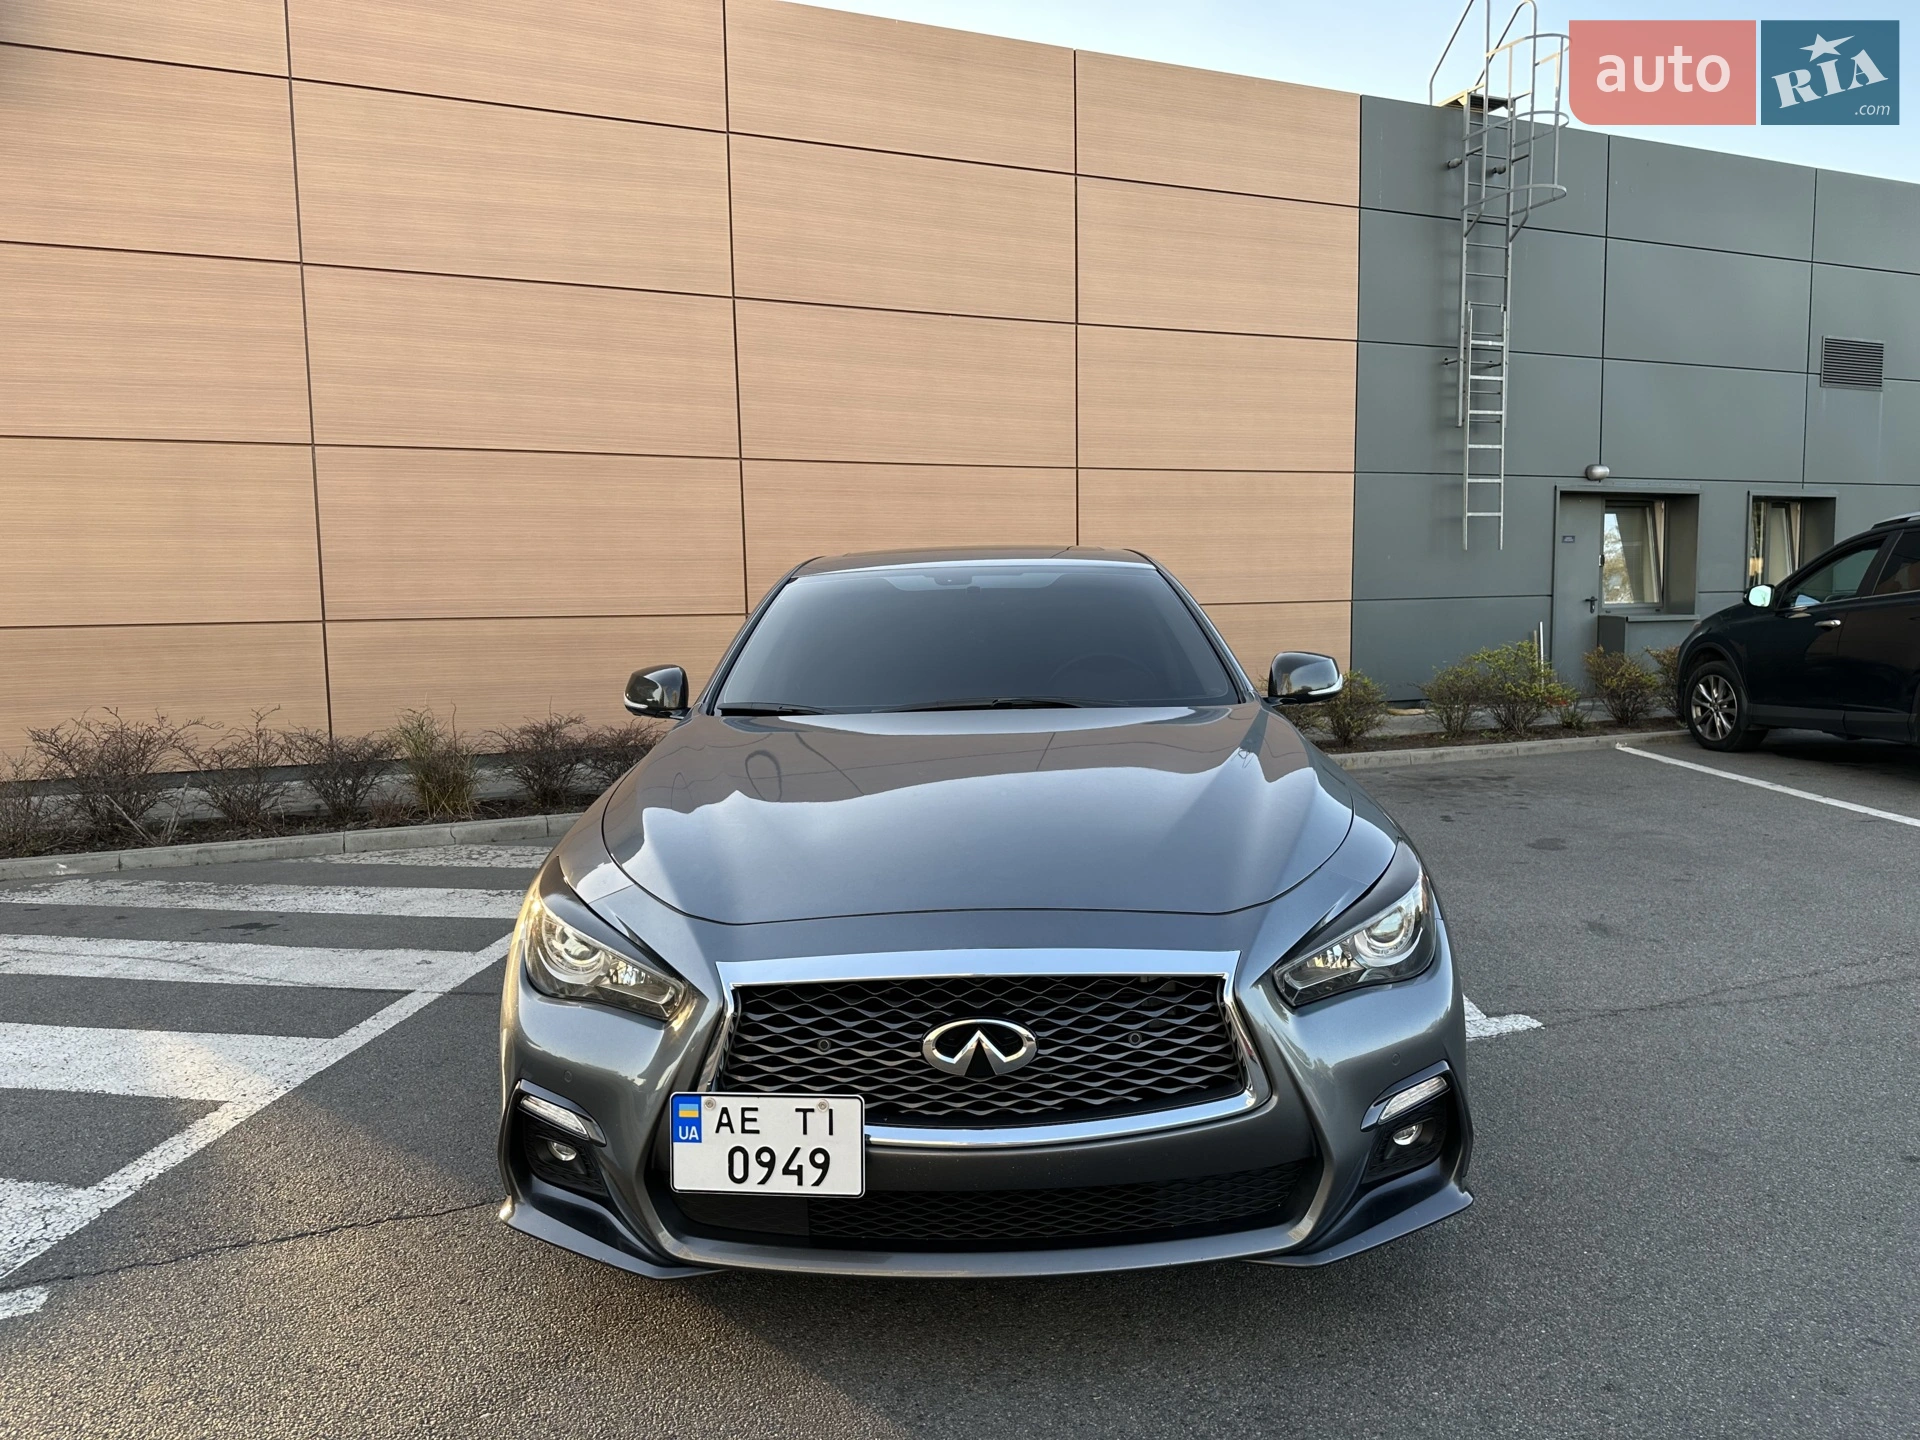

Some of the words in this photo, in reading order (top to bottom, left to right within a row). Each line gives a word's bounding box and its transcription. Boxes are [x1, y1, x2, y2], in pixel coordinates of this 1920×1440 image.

[678, 1125, 700, 1141] UA
[715, 1106, 760, 1135] AE
[795, 1107, 834, 1136] TI
[727, 1145, 831, 1187] 0949
